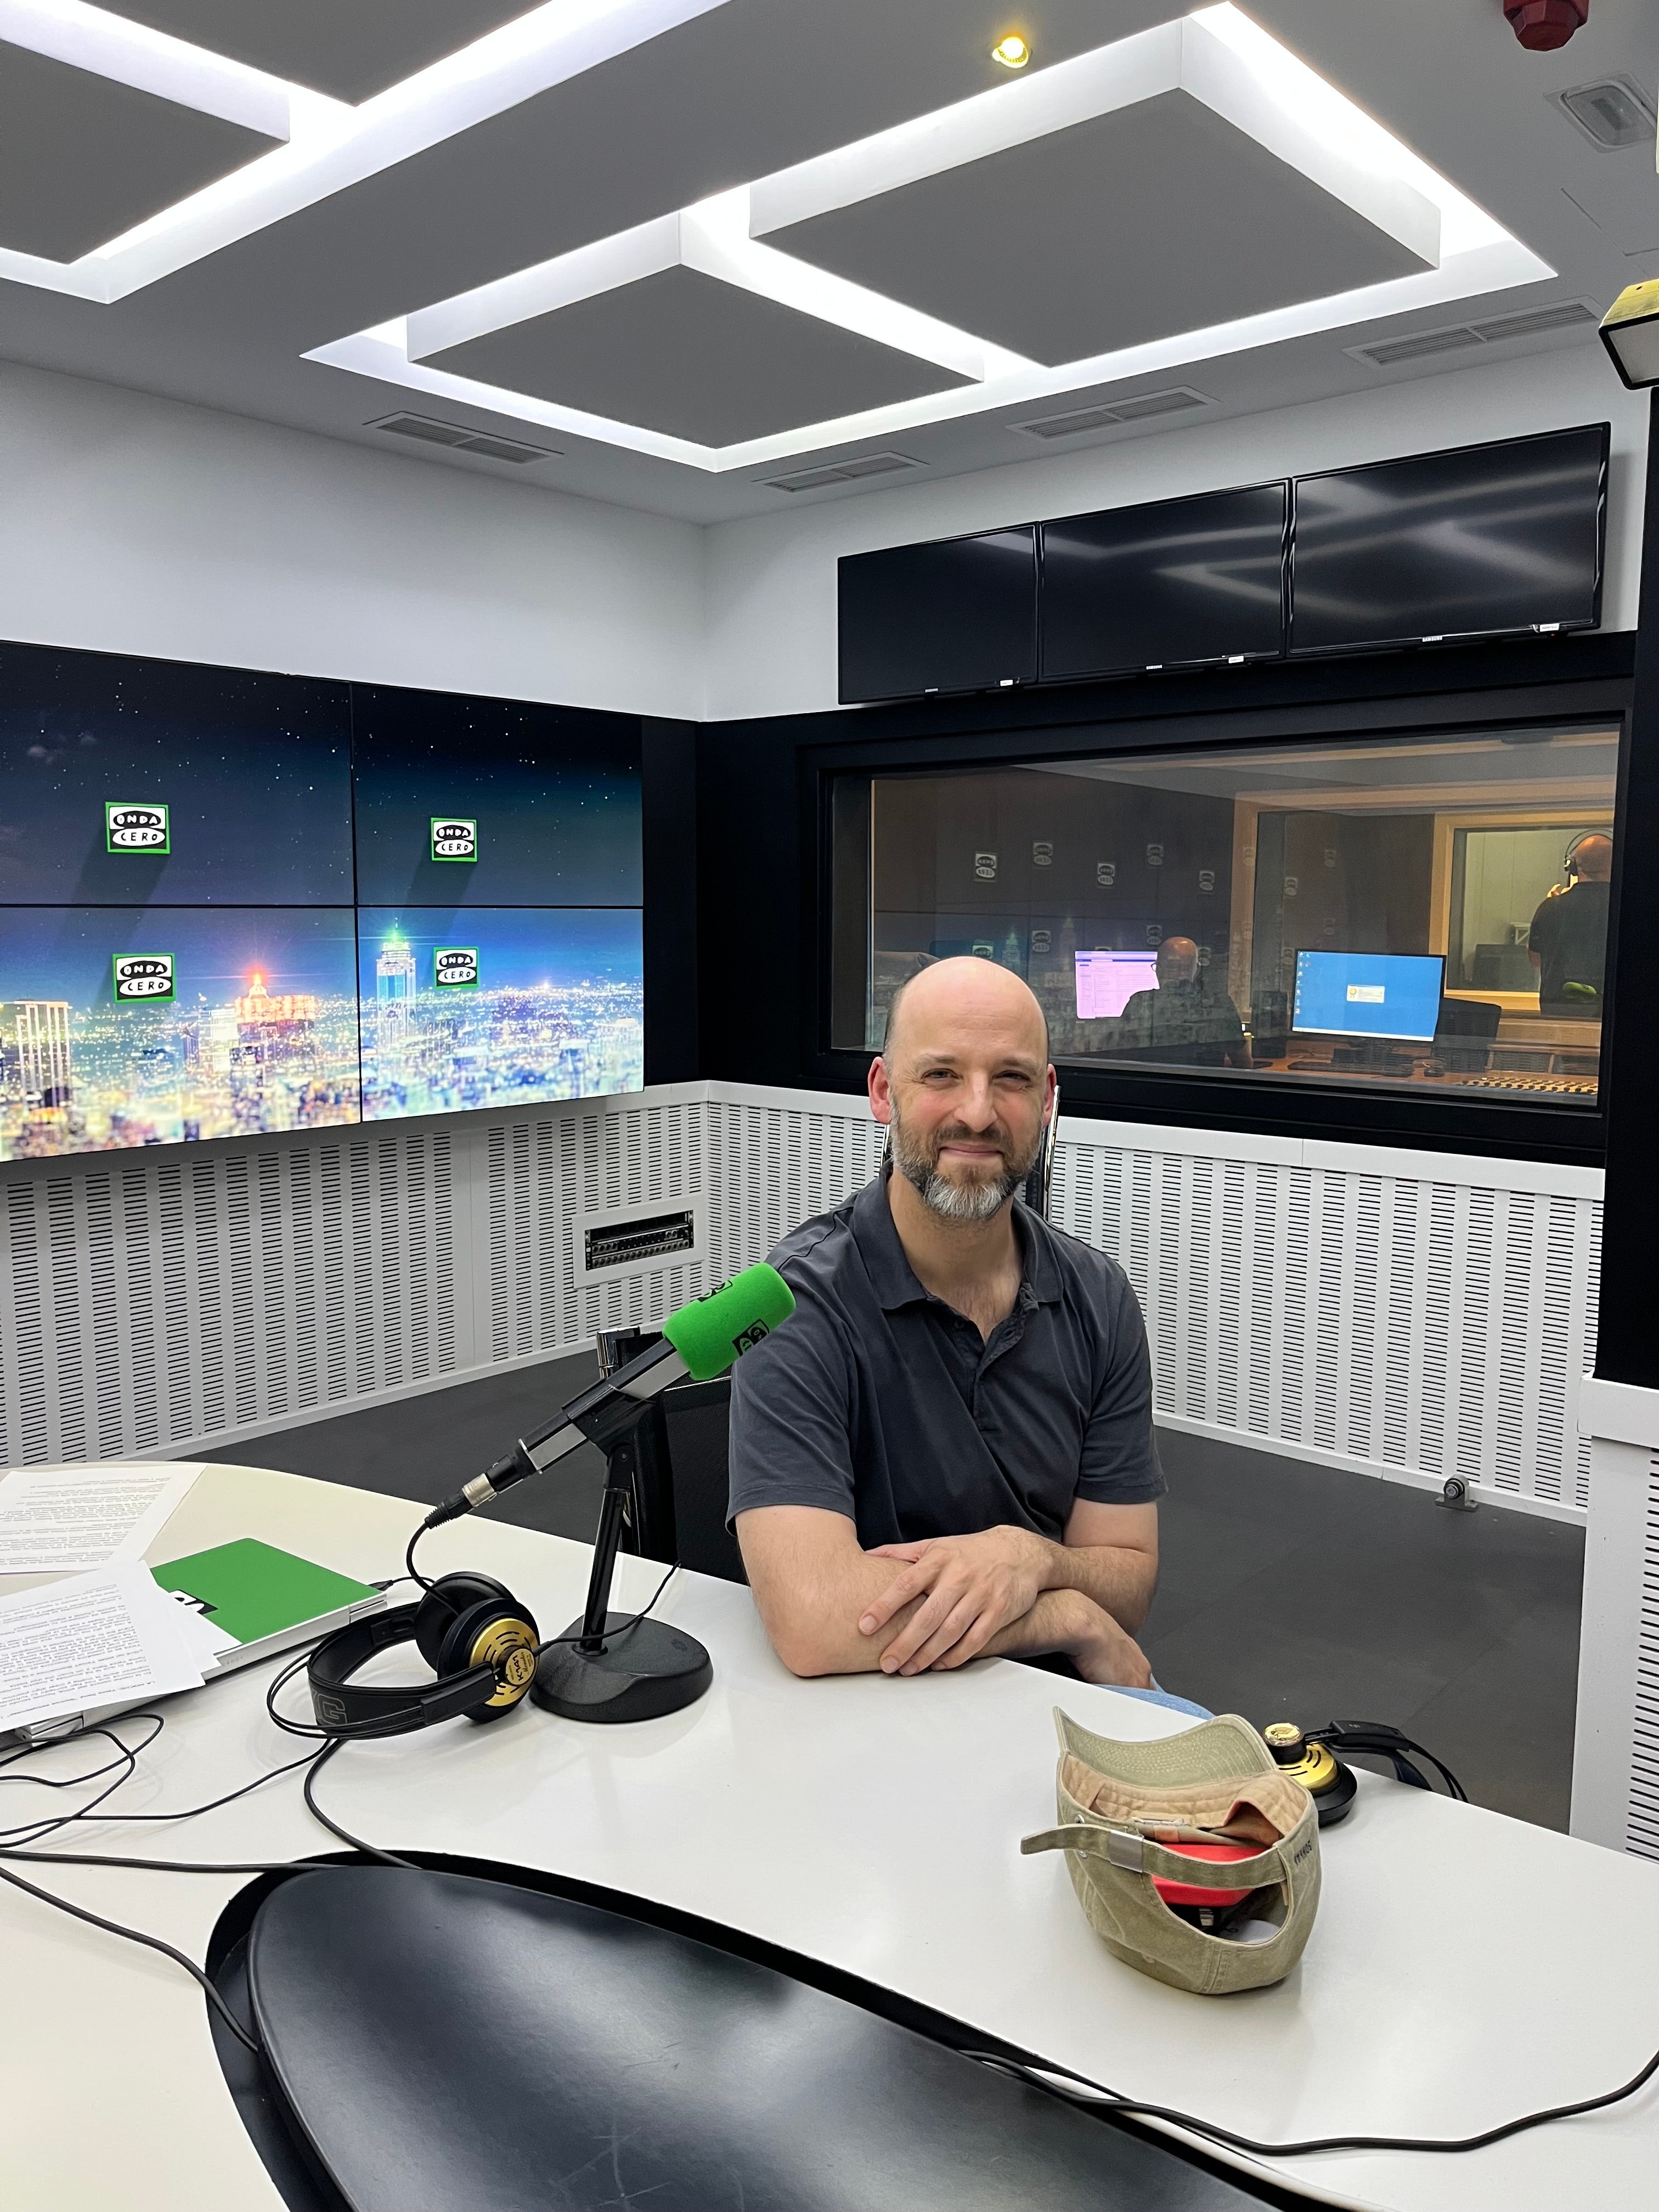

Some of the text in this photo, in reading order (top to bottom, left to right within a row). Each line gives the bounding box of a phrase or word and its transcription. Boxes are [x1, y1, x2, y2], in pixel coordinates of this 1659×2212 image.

[116, 815, 158, 825] ONDA
[120, 832, 158, 842] CERO
[438, 828, 469, 837] ONDA
[441, 843, 469, 851] CERO
[441, 956, 471, 966] ONDA
[123, 964, 165, 975] ONDA
[444, 970, 471, 979] CERO
[127, 981, 164, 991] CERO
